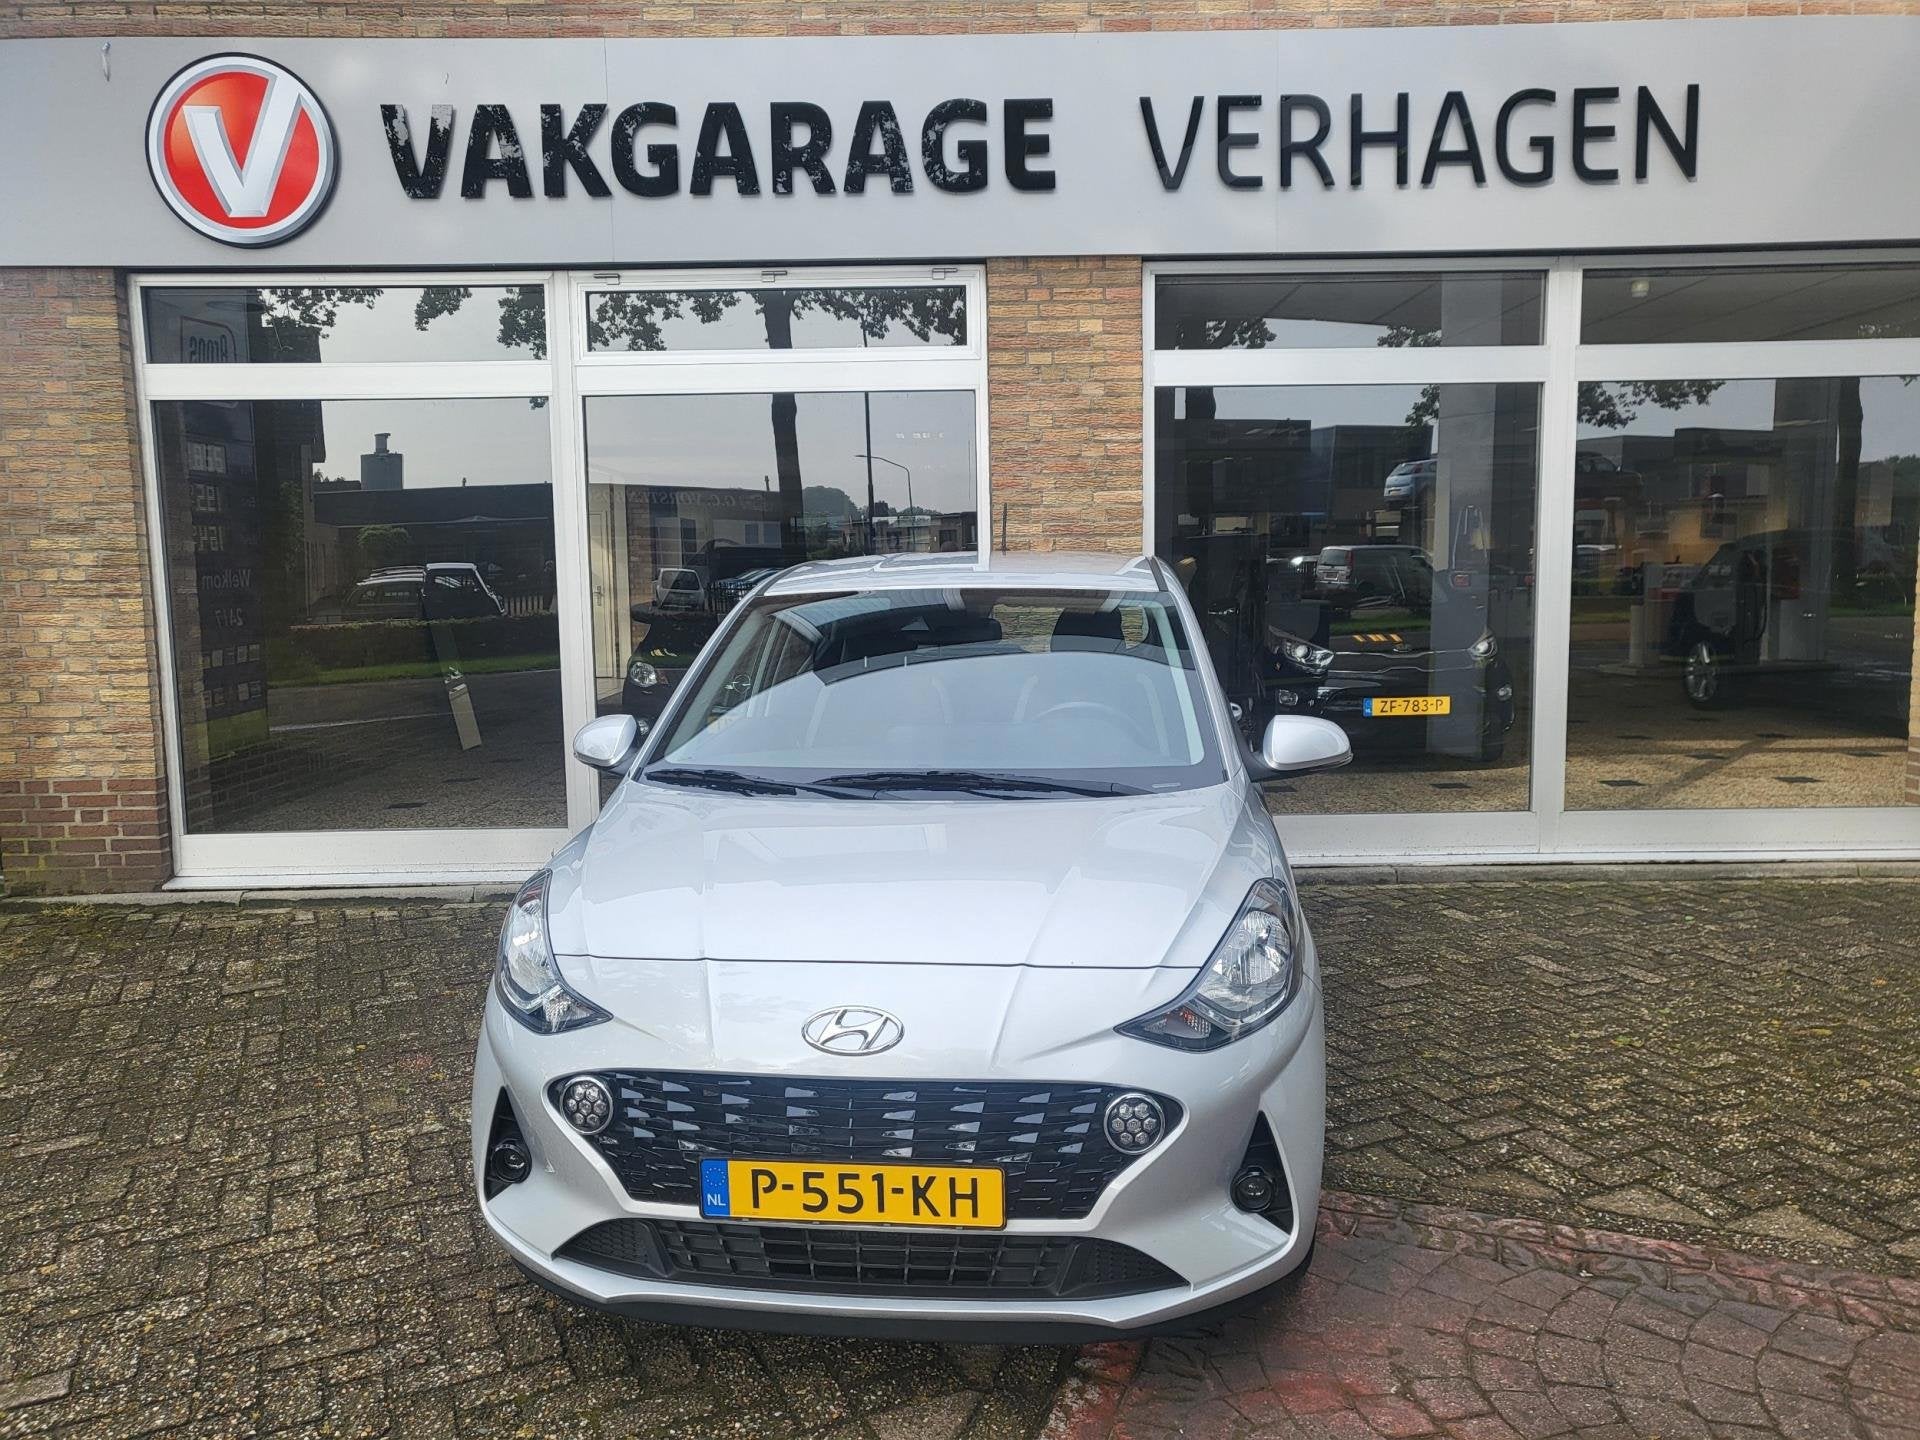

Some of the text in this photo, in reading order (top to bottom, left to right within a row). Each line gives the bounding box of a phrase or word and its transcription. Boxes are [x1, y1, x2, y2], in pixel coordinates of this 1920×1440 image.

[379, 84, 1700, 199] VAKGARAGE VERHAGEN
[1380, 699, 1444, 713] ZF-783-P
[706, 1168, 979, 1219] NL P-551-KH
